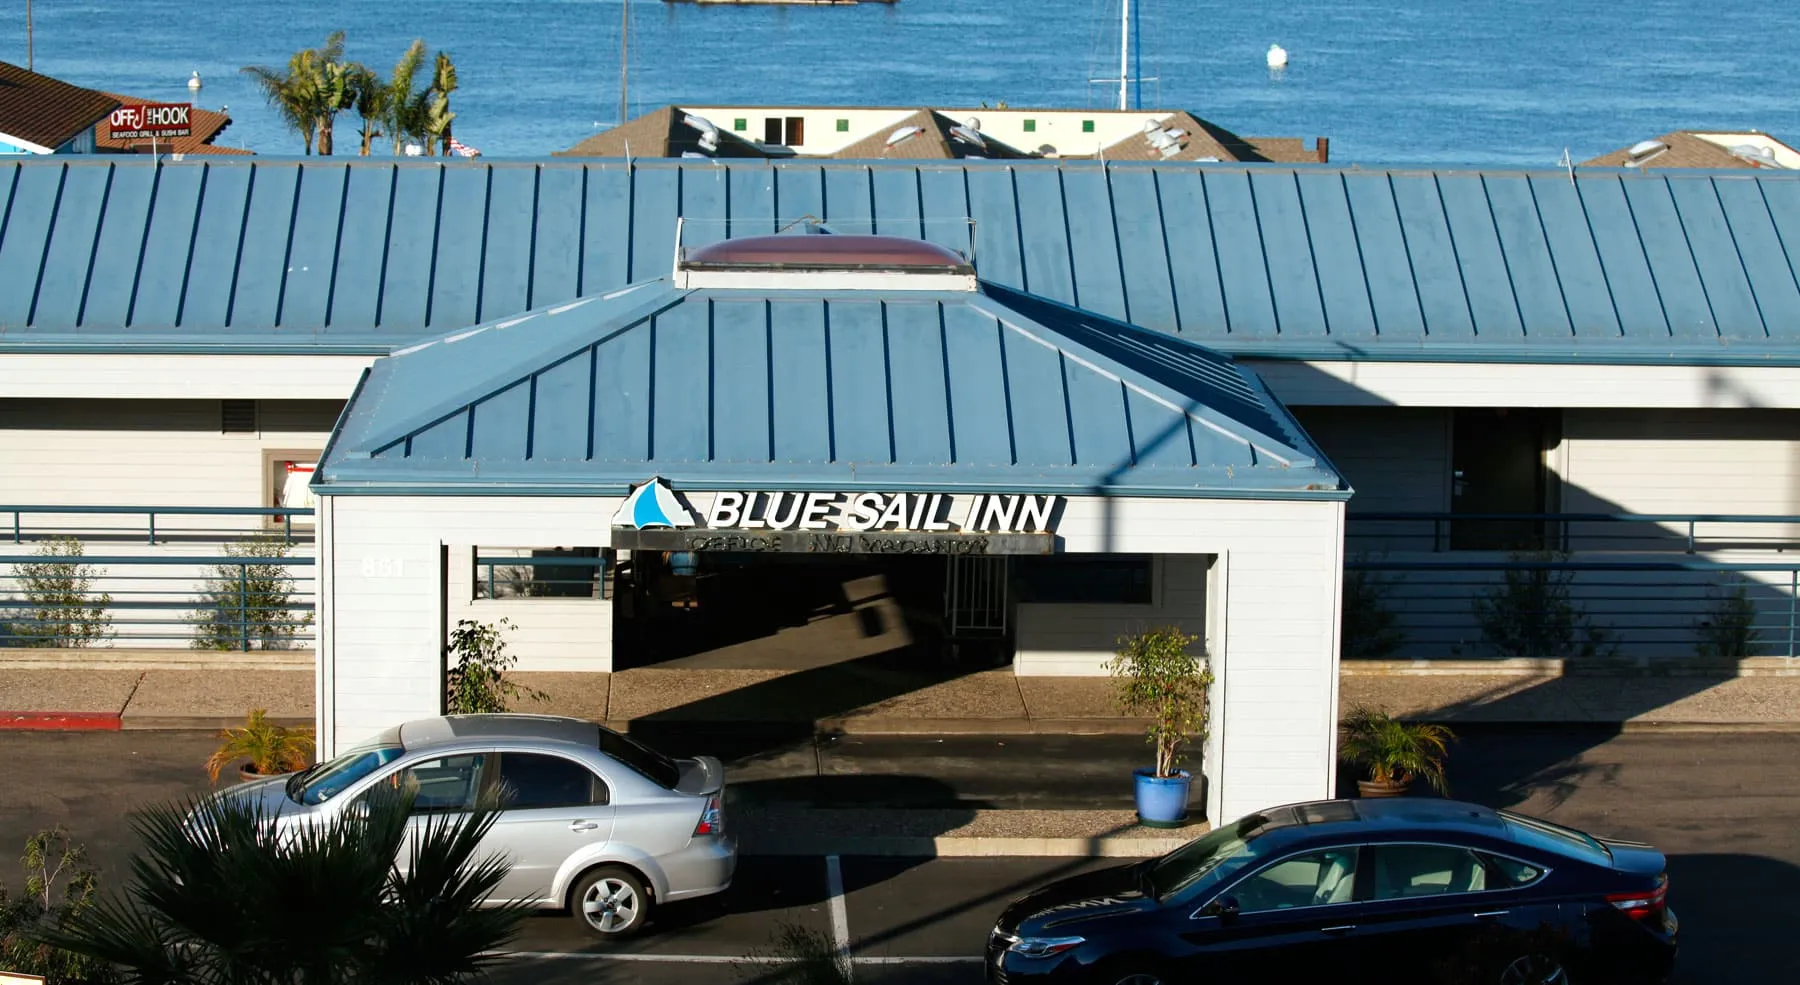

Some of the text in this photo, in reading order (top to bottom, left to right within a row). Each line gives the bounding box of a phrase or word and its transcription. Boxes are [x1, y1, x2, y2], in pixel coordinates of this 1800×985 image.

[110, 109, 136, 126] OFF
[152, 107, 189, 125] HOOK
[707, 491, 1057, 531] BLUE SAIL INN
[689, 535, 783, 551] OFFICE
